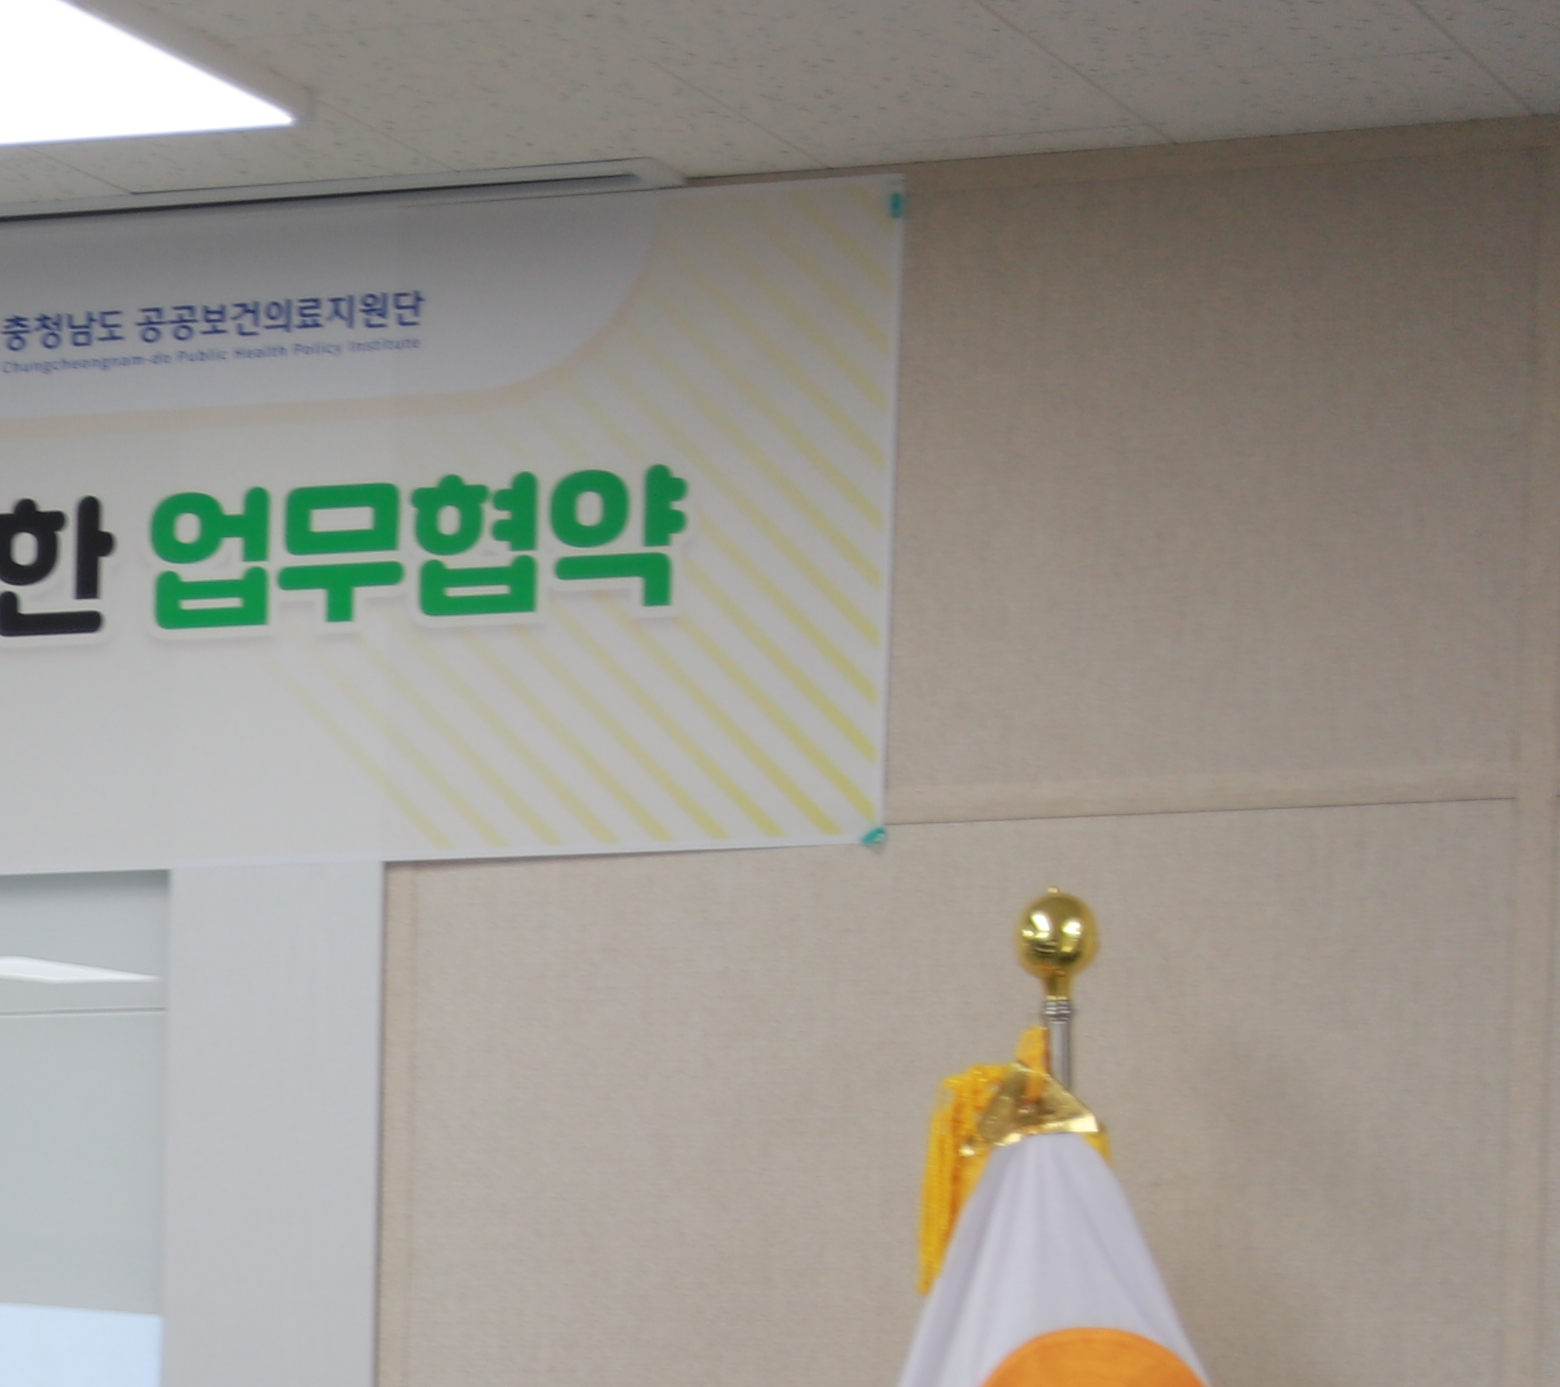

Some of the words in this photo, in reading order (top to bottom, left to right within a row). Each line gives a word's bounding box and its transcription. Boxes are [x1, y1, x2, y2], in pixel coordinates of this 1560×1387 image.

[1, 309, 124, 352] 충청남도
[136, 290, 425, 343] 공공보건의료지원단
[149, 463, 689, 630] 업무협약
